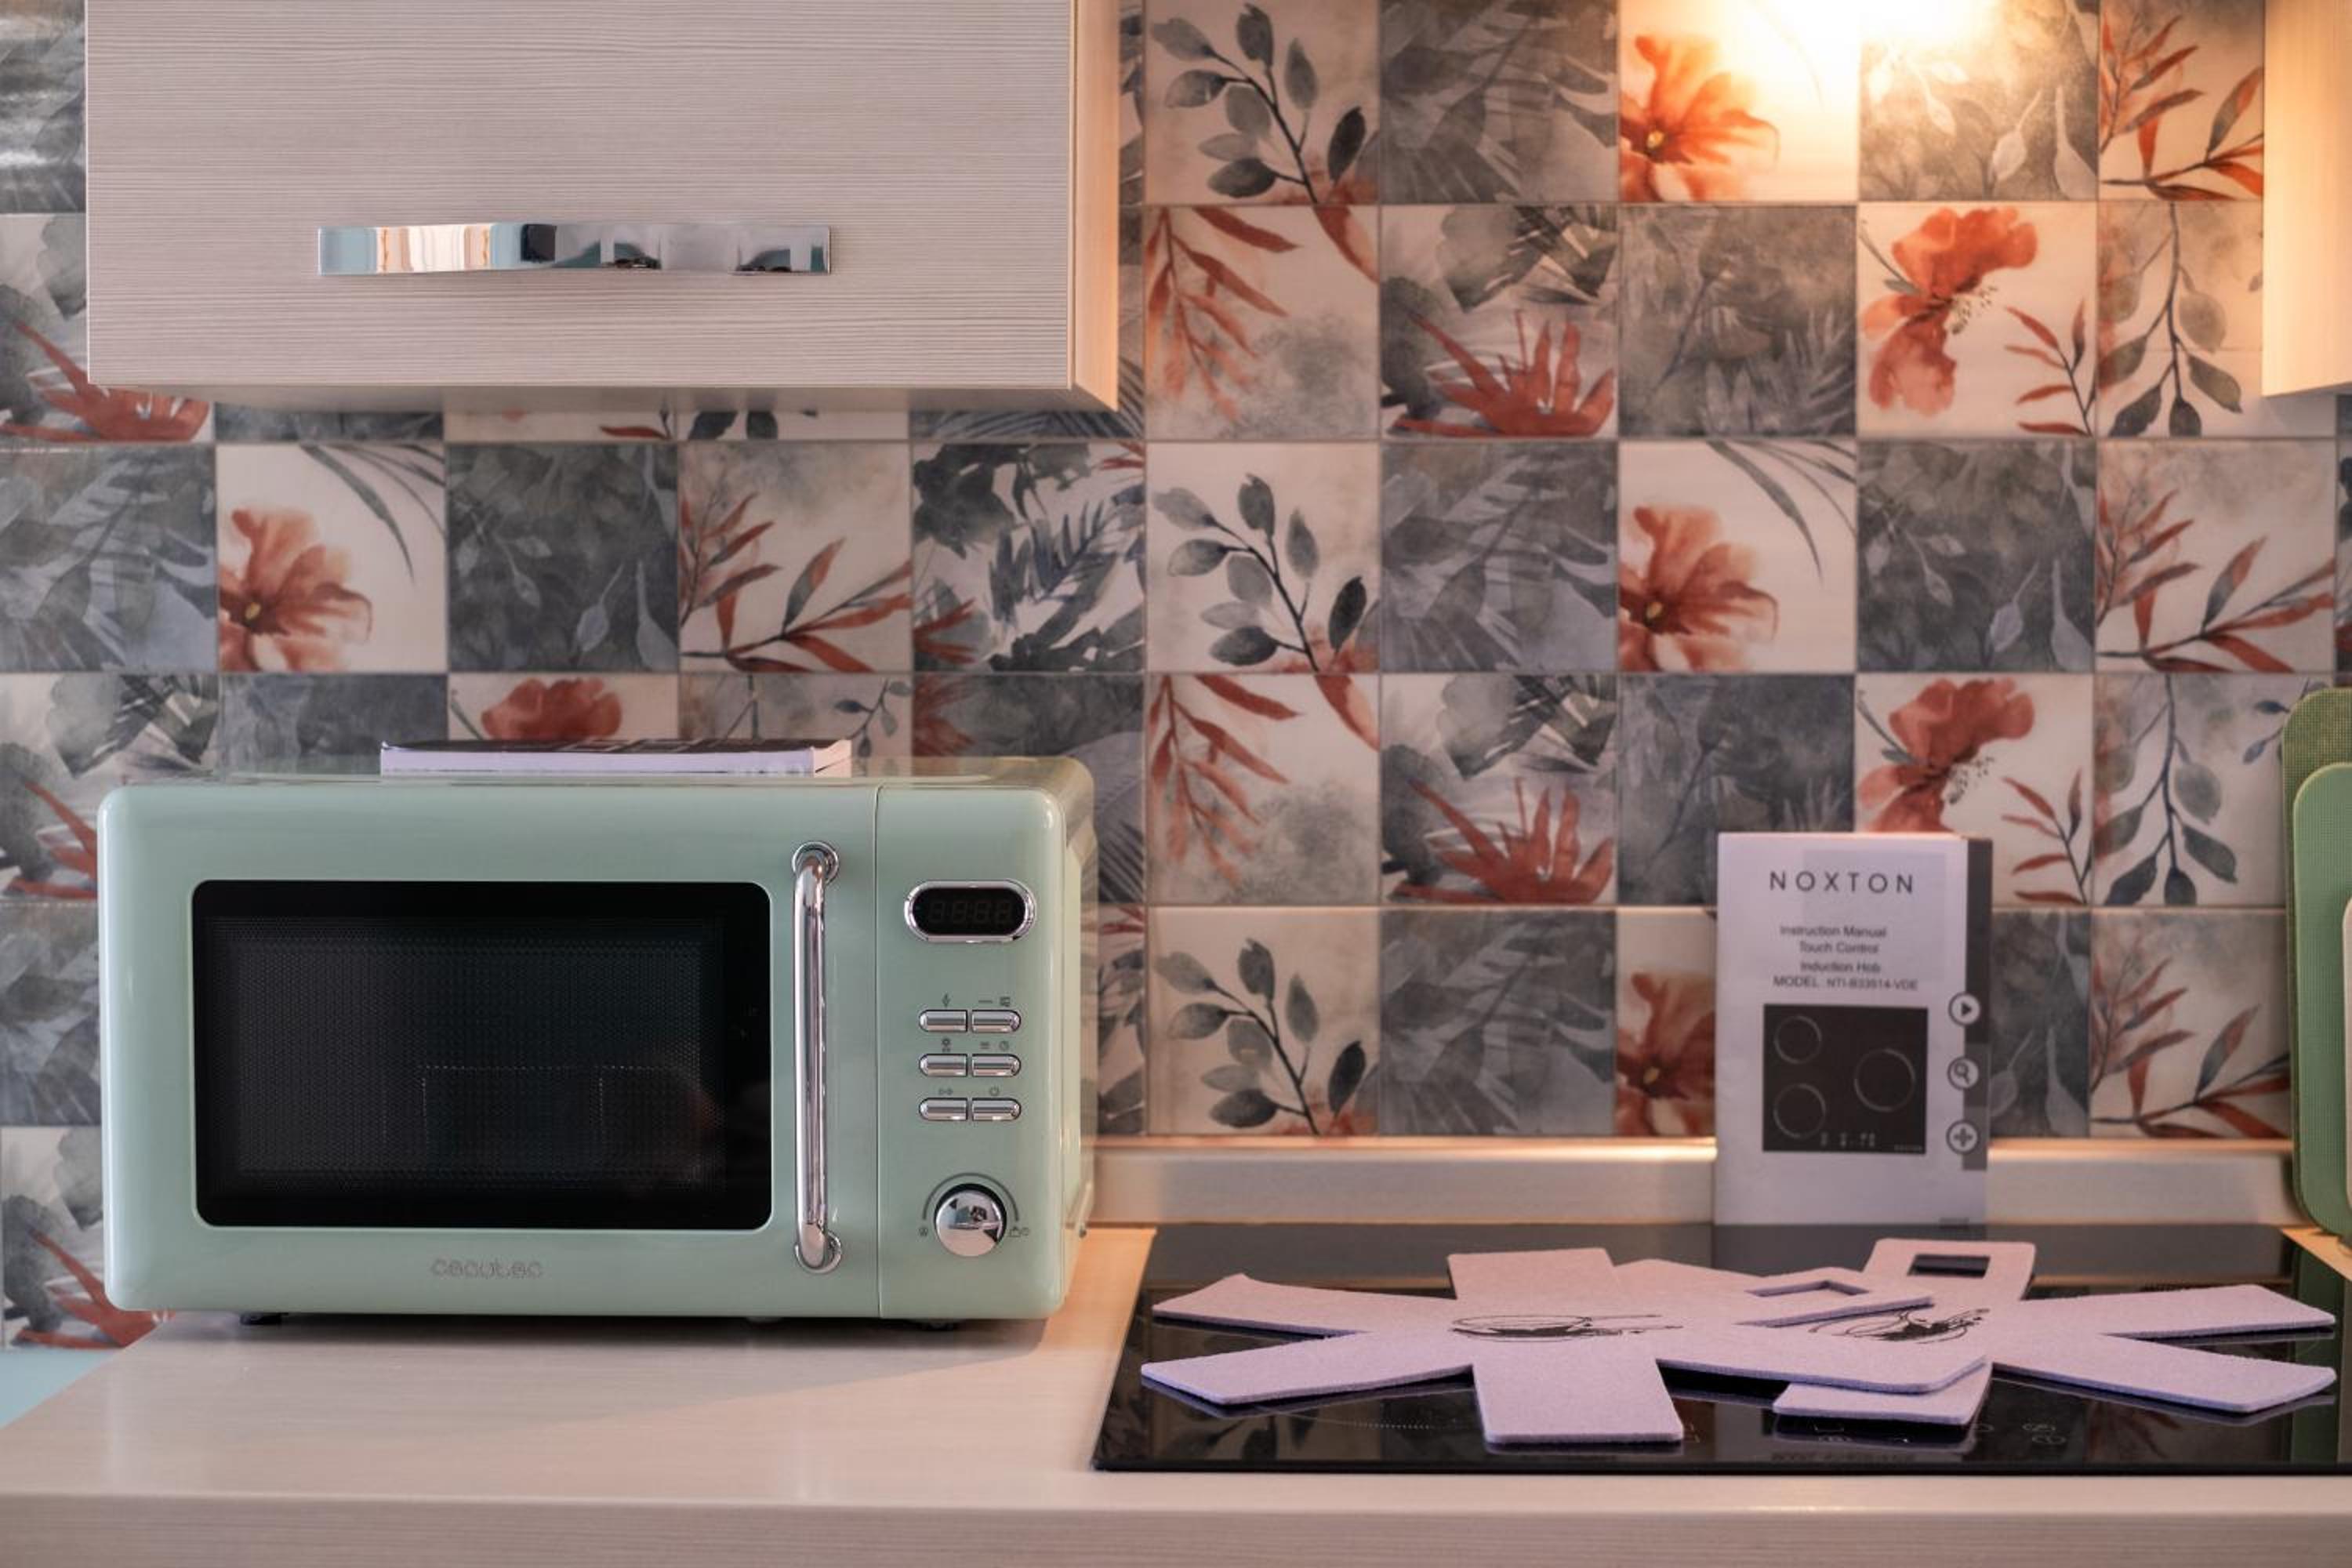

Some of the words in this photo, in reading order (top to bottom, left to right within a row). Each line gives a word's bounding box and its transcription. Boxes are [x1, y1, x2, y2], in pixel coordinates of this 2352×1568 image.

[1769, 871, 1913, 894] NOXTON
[1780, 925, 1841, 938] Instruction
[1843, 926, 1887, 938] Manual
[1799, 940, 1832, 953] Touch
[1836, 941, 1878, 953] Control
[1800, 961, 1853, 974] Induction
[1857, 963, 1881, 974] Hob
